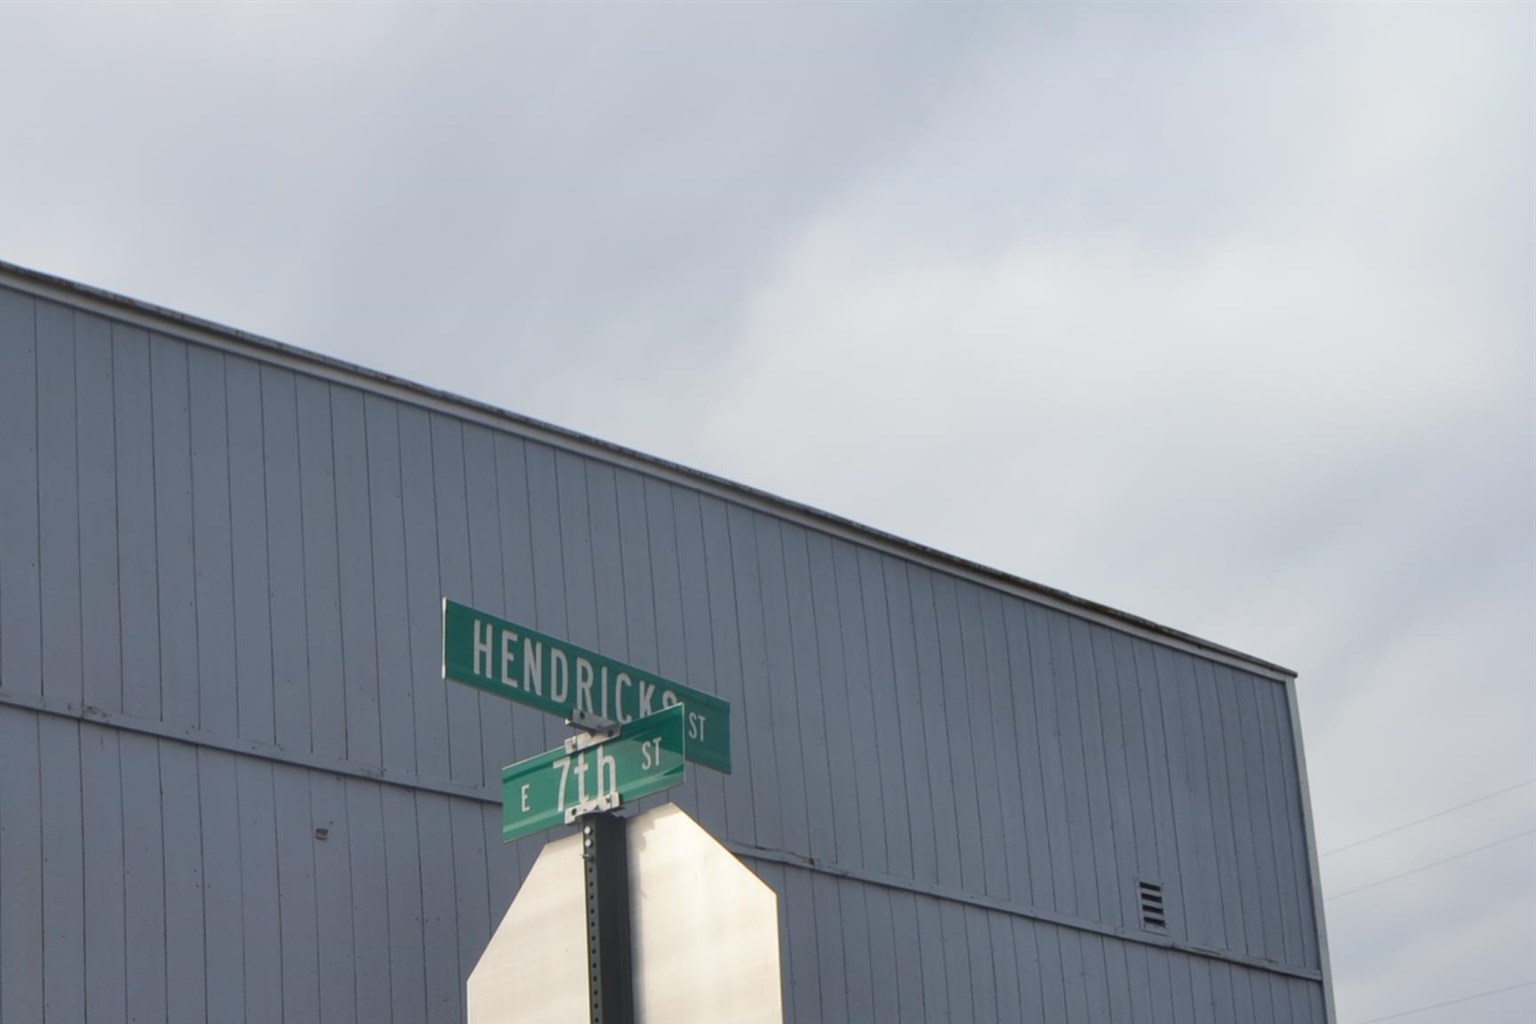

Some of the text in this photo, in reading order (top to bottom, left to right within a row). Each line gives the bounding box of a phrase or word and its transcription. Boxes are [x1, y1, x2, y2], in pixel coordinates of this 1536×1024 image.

[688, 711, 706, 742] ST
[521, 736, 662, 813] E 7th ST
